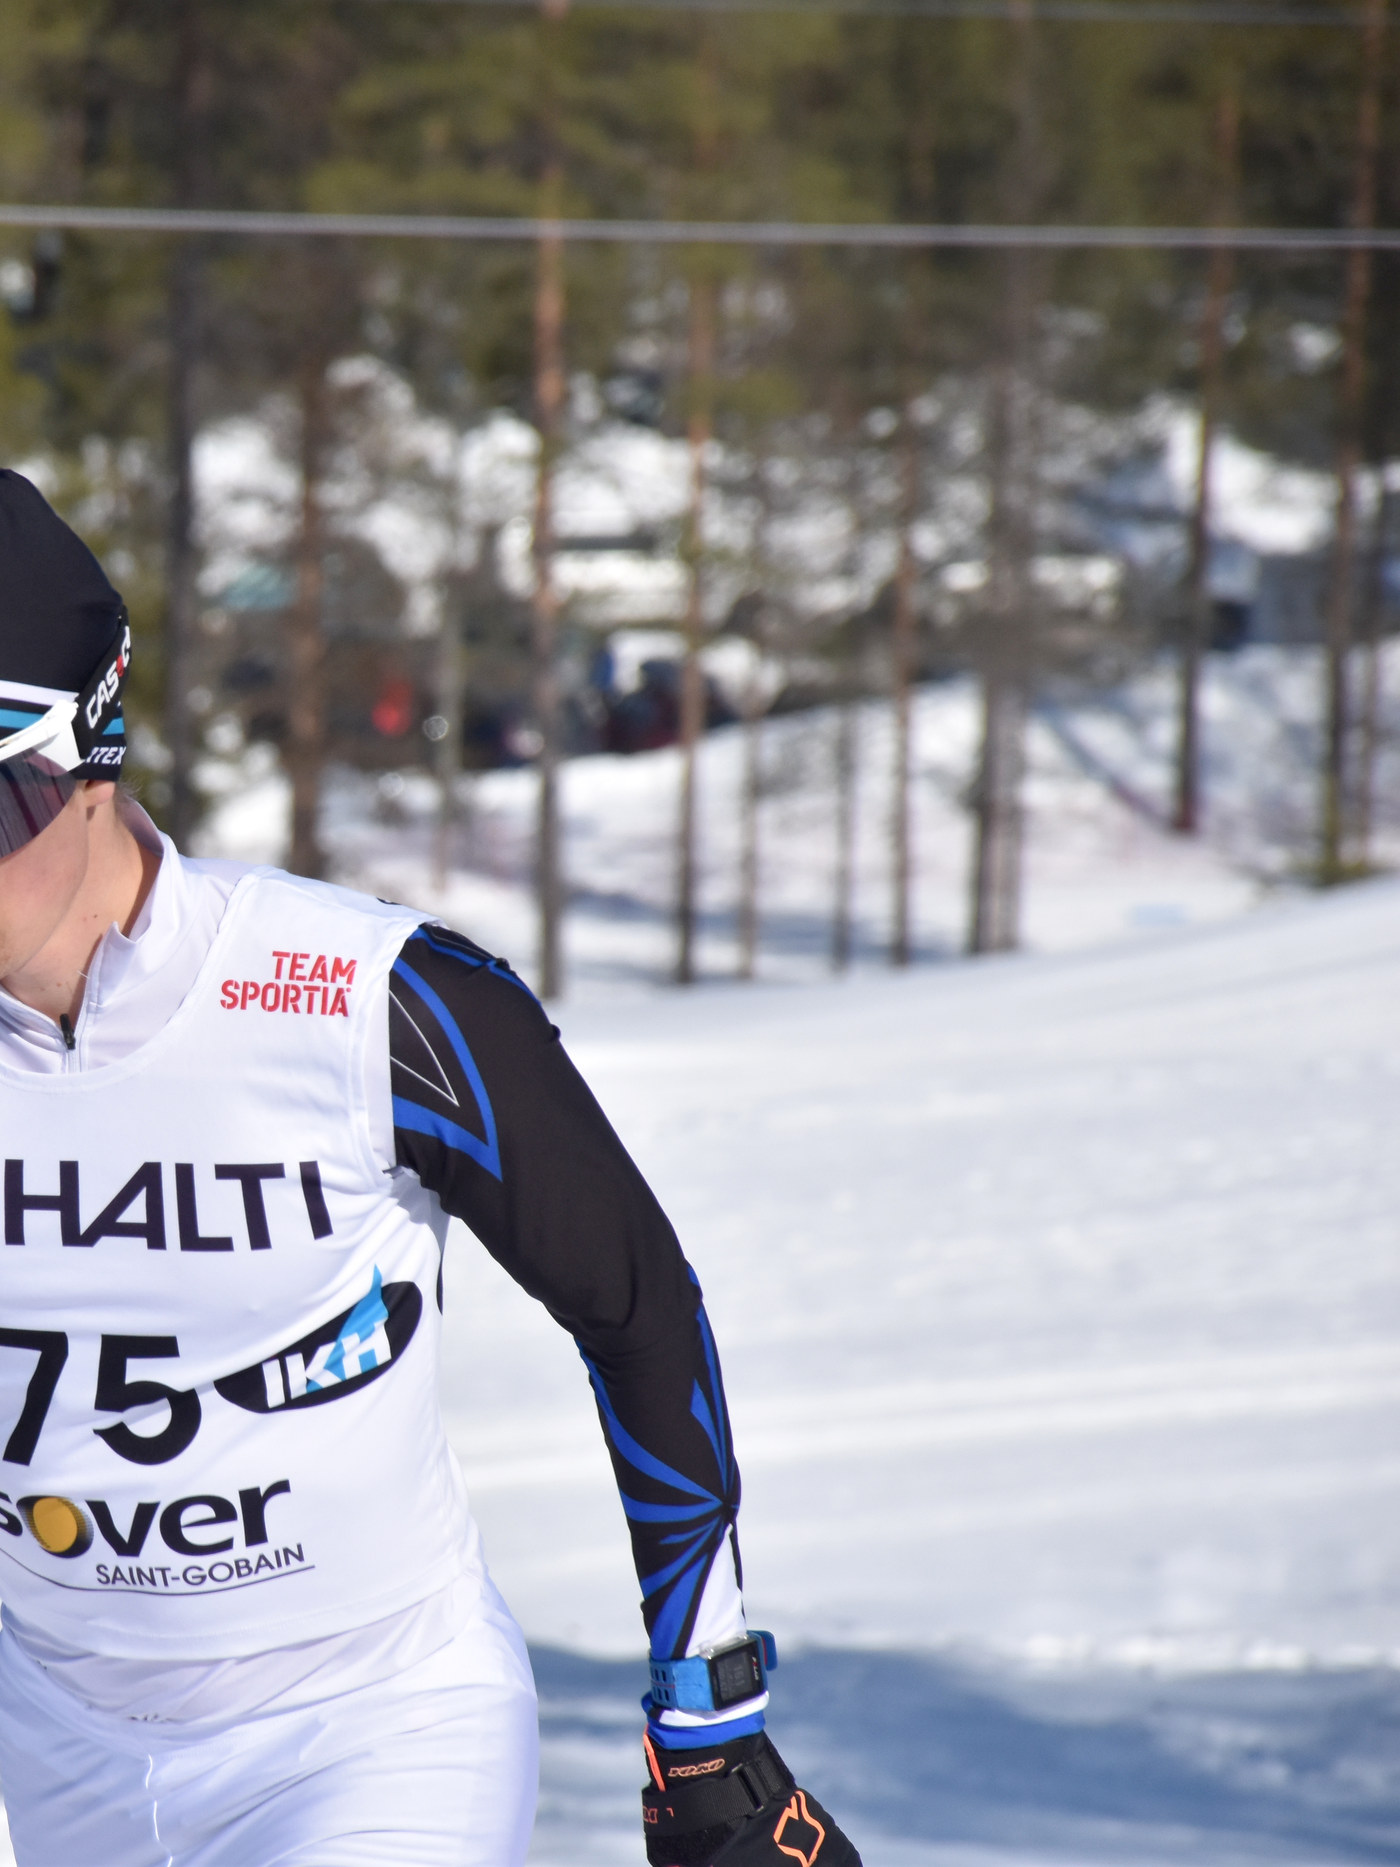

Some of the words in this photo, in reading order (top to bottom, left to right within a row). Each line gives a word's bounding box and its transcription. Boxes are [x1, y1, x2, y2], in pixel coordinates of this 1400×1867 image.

[272, 950, 358, 985] TEAM
[220, 979, 349, 1018] SPORTIA
[3, 1158, 334, 1252] HALTI
[261, 1318, 392, 1409] IKH
[95, 1543, 305, 1588] SAINT-GOBAIN
